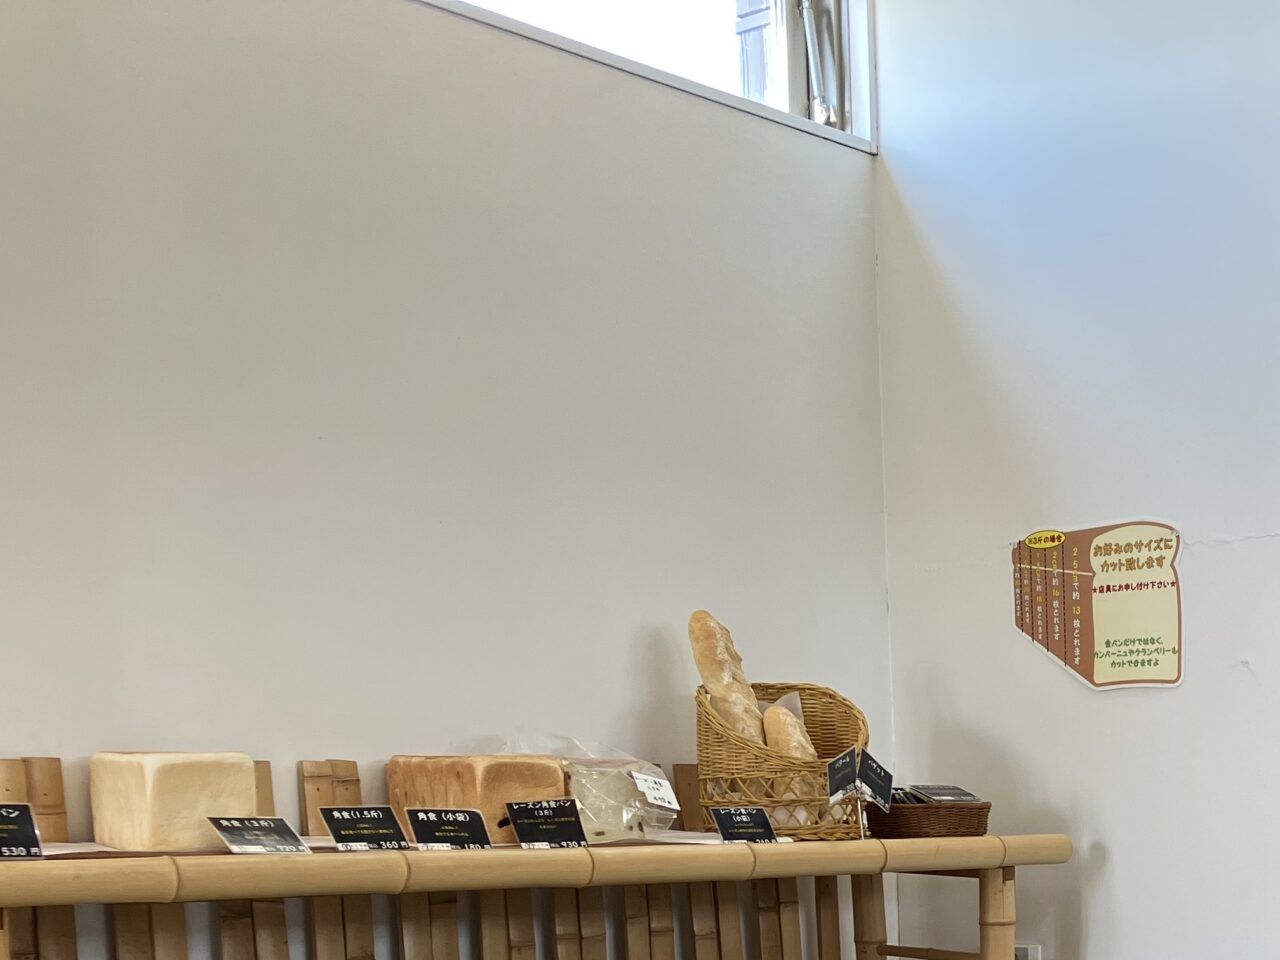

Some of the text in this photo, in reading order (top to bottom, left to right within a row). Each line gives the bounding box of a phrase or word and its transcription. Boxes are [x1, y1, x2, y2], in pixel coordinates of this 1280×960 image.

[1092, 538, 1174, 558] お好みのサイズに
[1100, 554, 1166, 573] カット致します
[1110, 658, 1160, 669] カットできますよ
[379, 841, 399, 849] 360
[0, 846, 27, 856] 530
